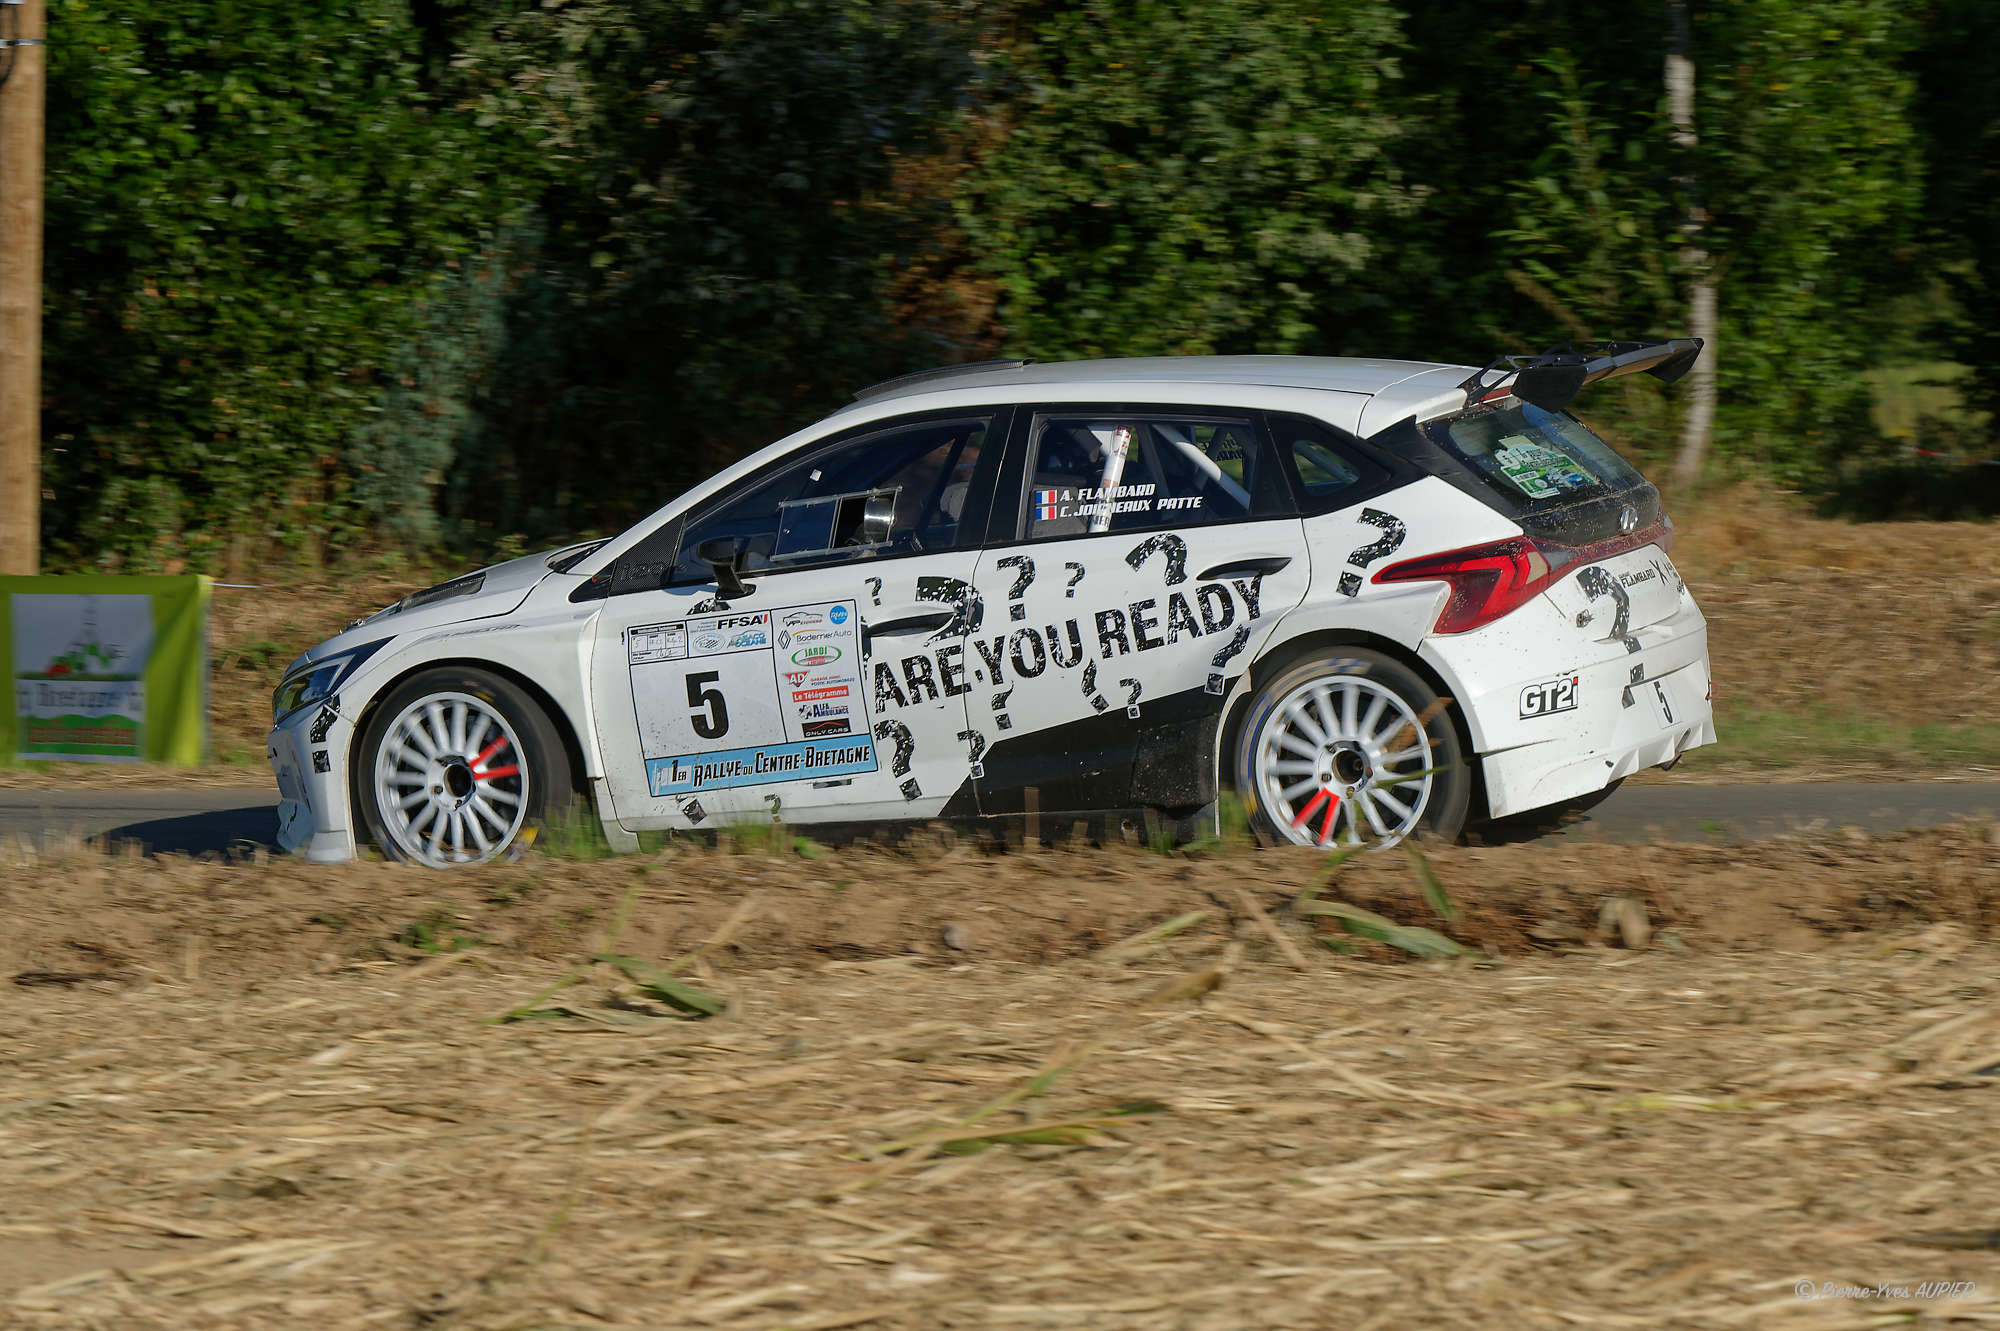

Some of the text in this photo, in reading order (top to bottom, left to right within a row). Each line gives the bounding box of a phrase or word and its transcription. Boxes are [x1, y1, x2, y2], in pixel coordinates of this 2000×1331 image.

[1060, 484, 1156, 502] A. FLAMBARD
[1156, 497, 1203, 511] PATTE
[1620, 568, 1656, 588] FLAMBARD
[717, 615, 763, 630] FFSA
[873, 572, 1263, 715] ARE YOU READY
[685, 670, 730, 739] 5
[1520, 677, 1578, 719] GT2i
[1653, 681, 1674, 724] 5
[693, 760, 741, 787] RALLYE
